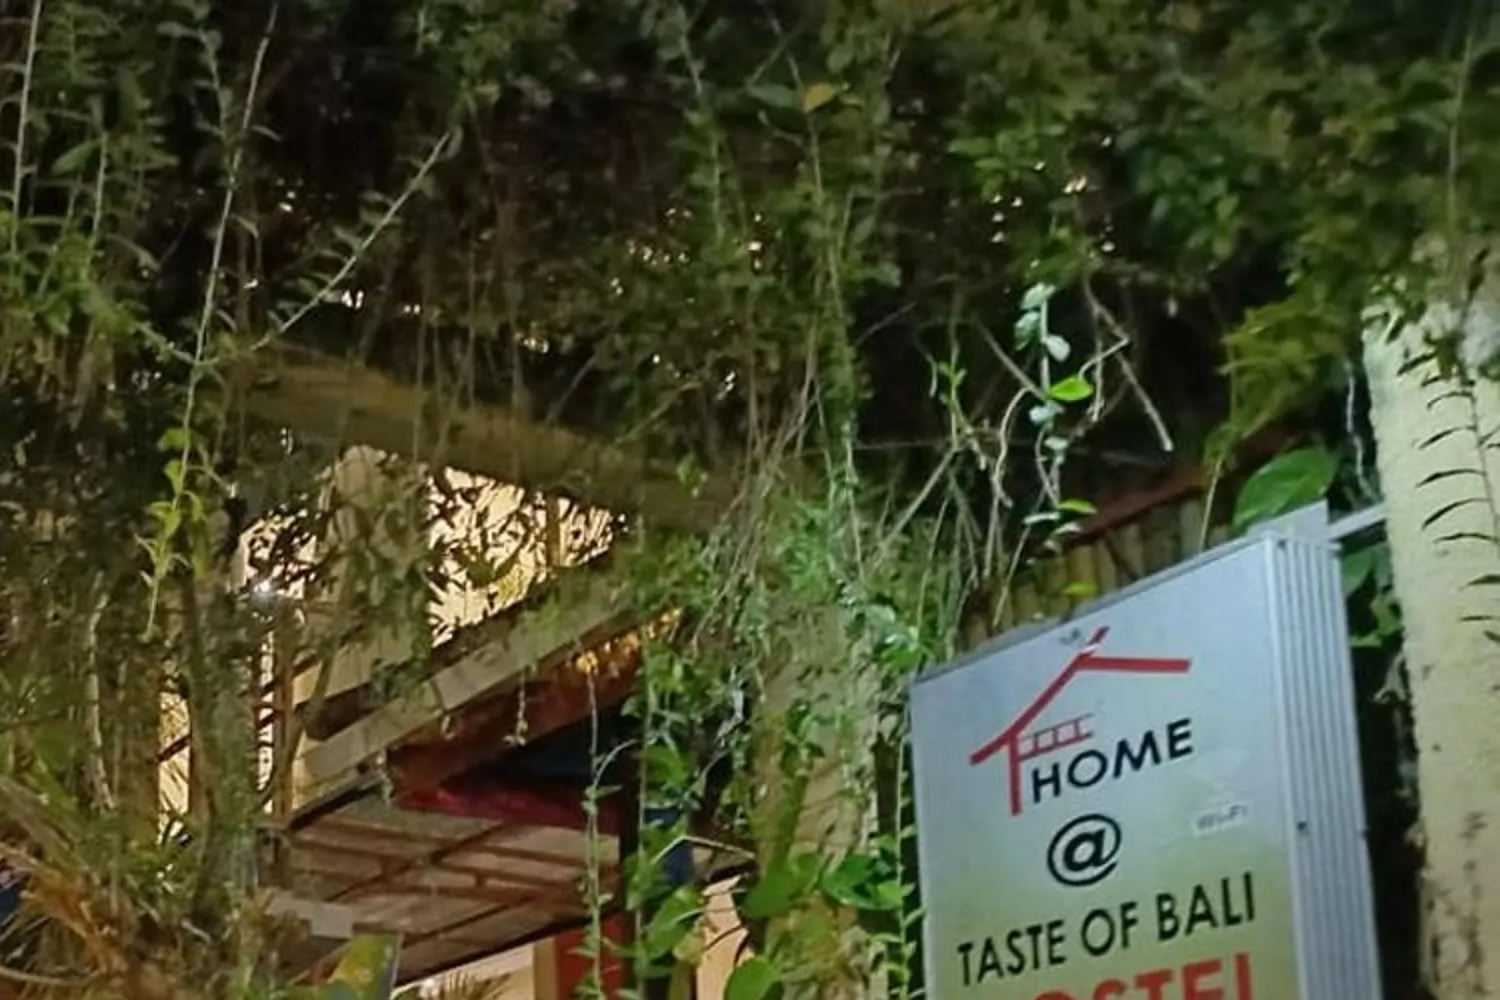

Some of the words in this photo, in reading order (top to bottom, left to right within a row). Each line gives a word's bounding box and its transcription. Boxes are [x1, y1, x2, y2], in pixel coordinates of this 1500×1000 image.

[1032, 717, 1193, 804] HOME
[1047, 813, 1122, 887] @
[956, 919, 1067, 987] TASTE
[1080, 901, 1139, 957] OF
[1155, 871, 1256, 943] BALI
